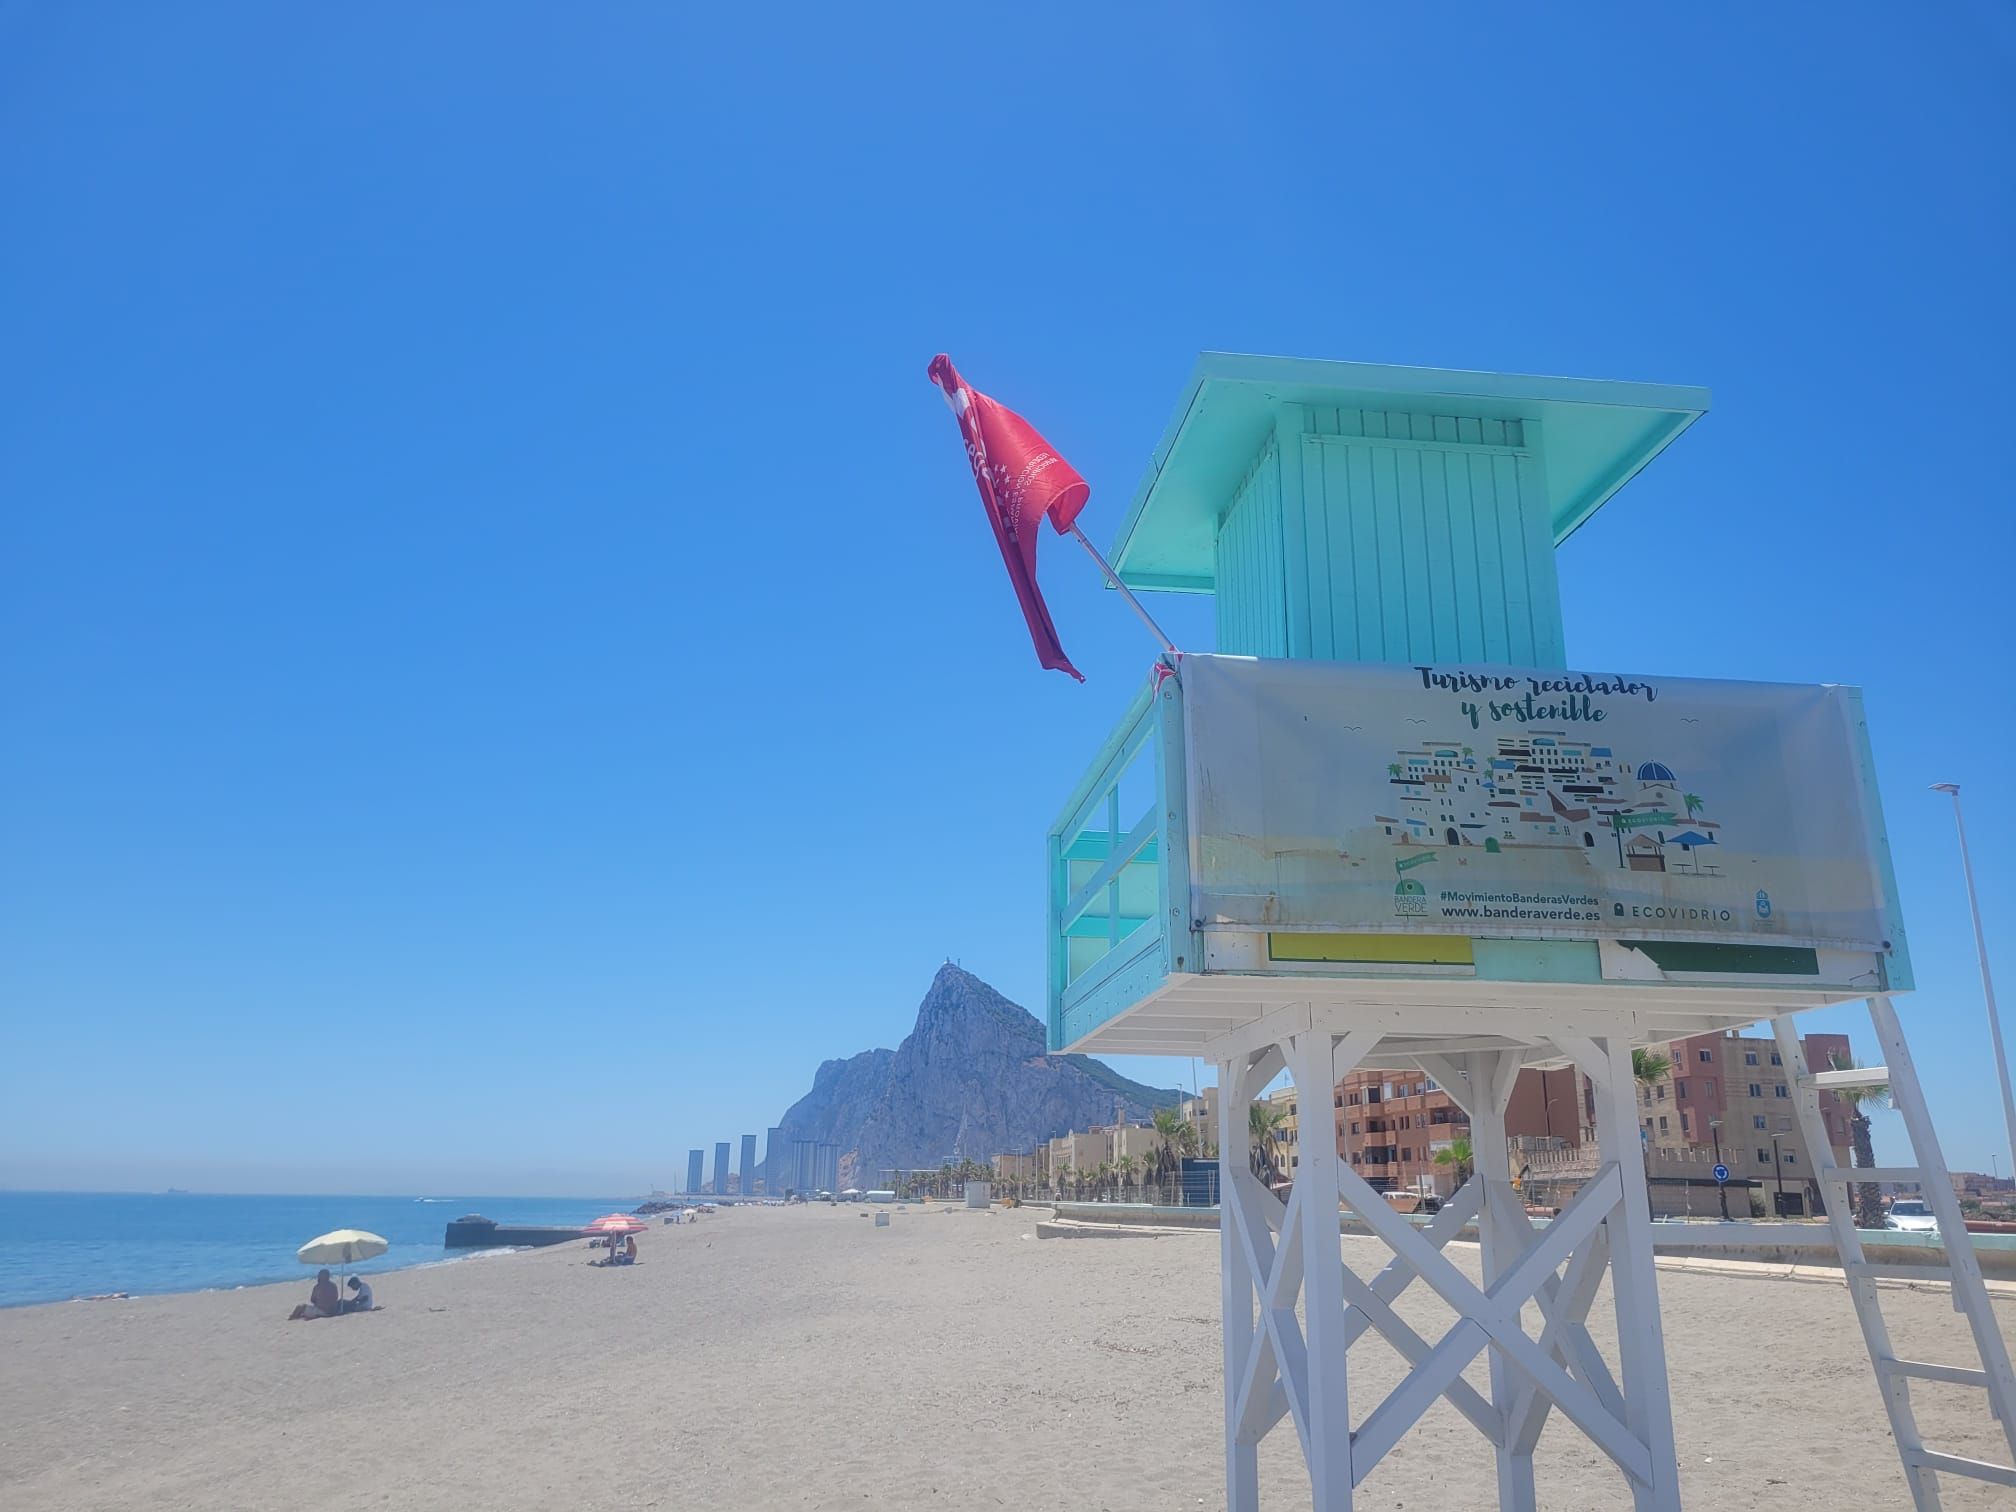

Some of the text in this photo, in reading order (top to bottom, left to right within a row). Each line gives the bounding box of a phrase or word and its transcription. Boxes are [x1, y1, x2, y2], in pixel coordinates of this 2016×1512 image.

[1414, 666, 1658, 702] Turismo reciclador
[1462, 692, 1608, 729] y sostenible
[1394, 896, 1427, 904] BANDERA
[1441, 891, 1599, 906] #MovimientoBanderasVerdes
[1395, 903, 1428, 913] VERDE
[1442, 905, 1601, 921] www.banderaverde.es
[1632, 906, 1731, 921] ECOVIDRIO
